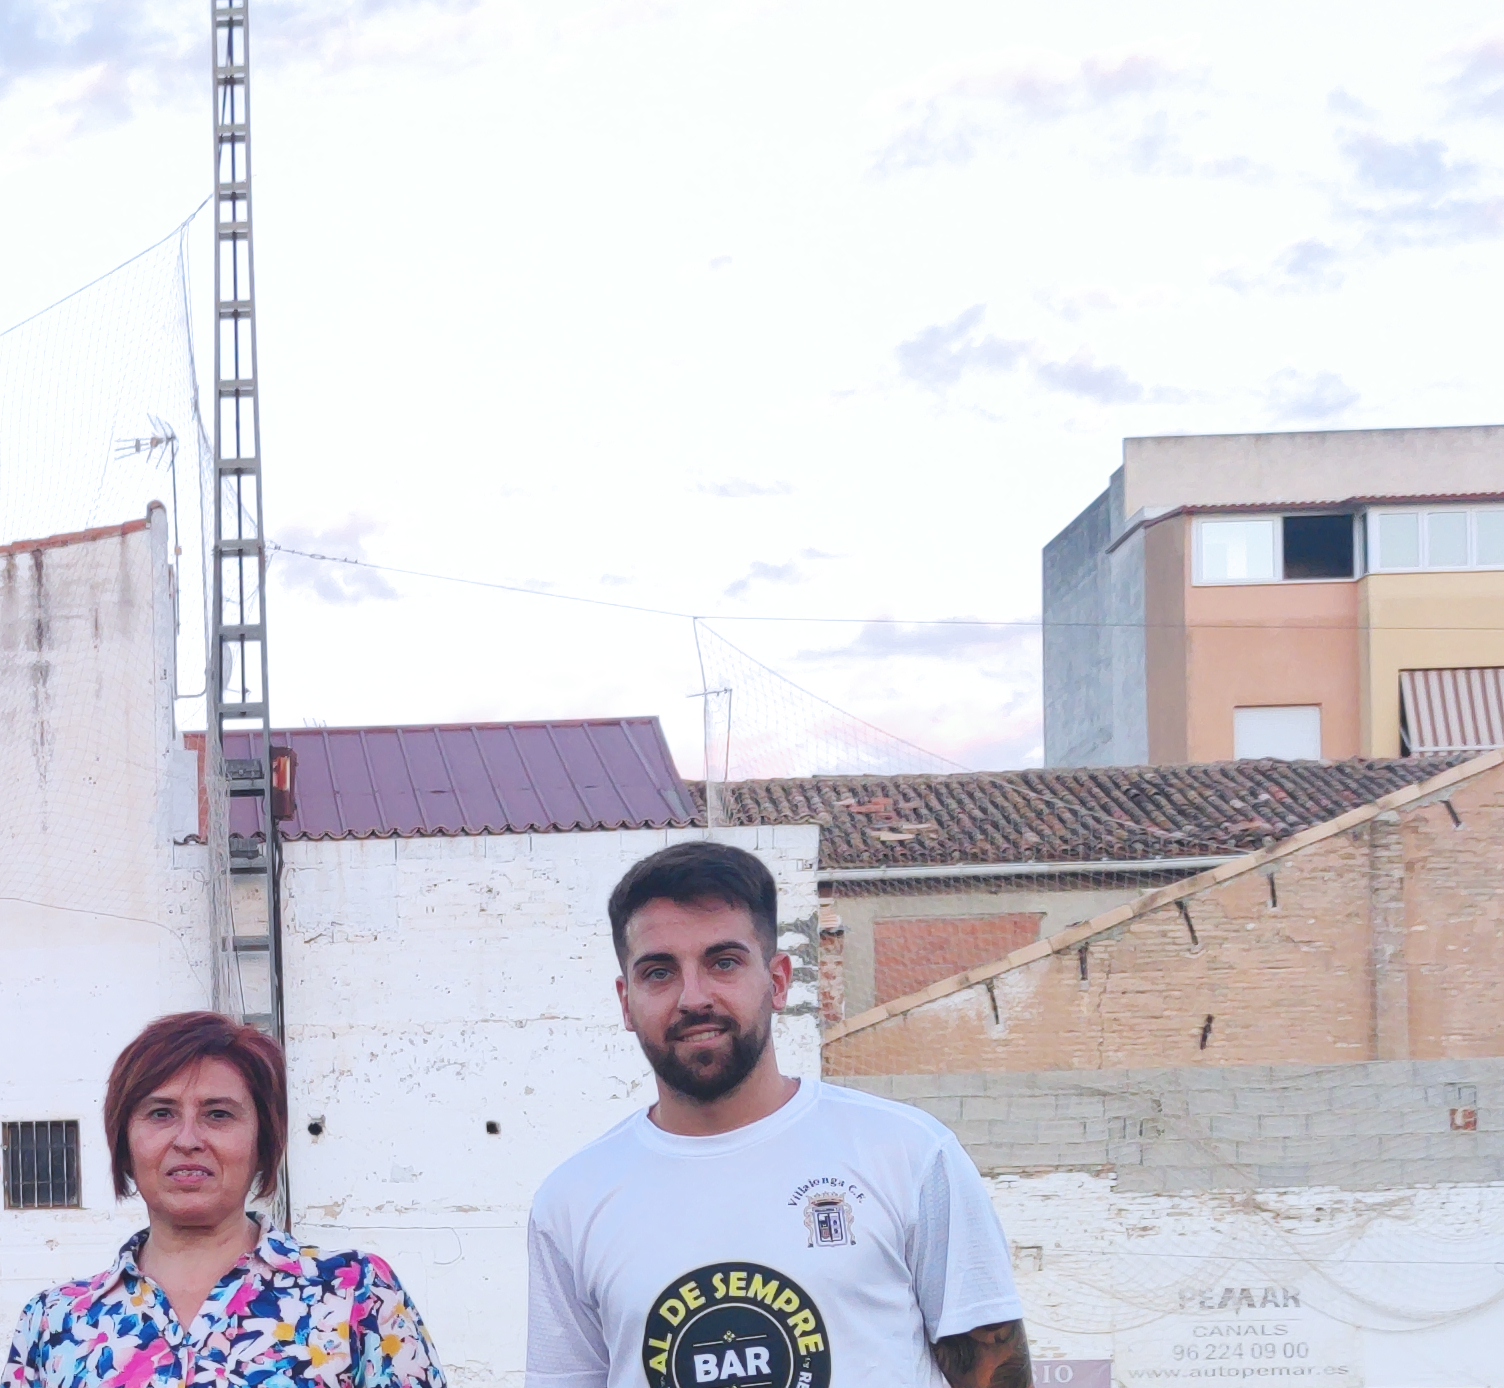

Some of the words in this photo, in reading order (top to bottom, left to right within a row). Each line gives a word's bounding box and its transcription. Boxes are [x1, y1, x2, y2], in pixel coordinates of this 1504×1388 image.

[788, 1178, 845, 1206] Villalonga
[659, 1281, 706, 1327] DE
[712, 1271, 825, 1356] SEMPRE
[1192, 1324, 1289, 1338] CANALS
[648, 1332, 673, 1375] AL
[693, 1346, 771, 1383] BAR
[1172, 1344, 1200, 1361] 96
[1205, 1344, 1243, 1361] 224
[1250, 1342, 1277, 1360] 09
[1282, 1341, 1310, 1359] 00
[1127, 1364, 1350, 1379] www.autopemar.es
